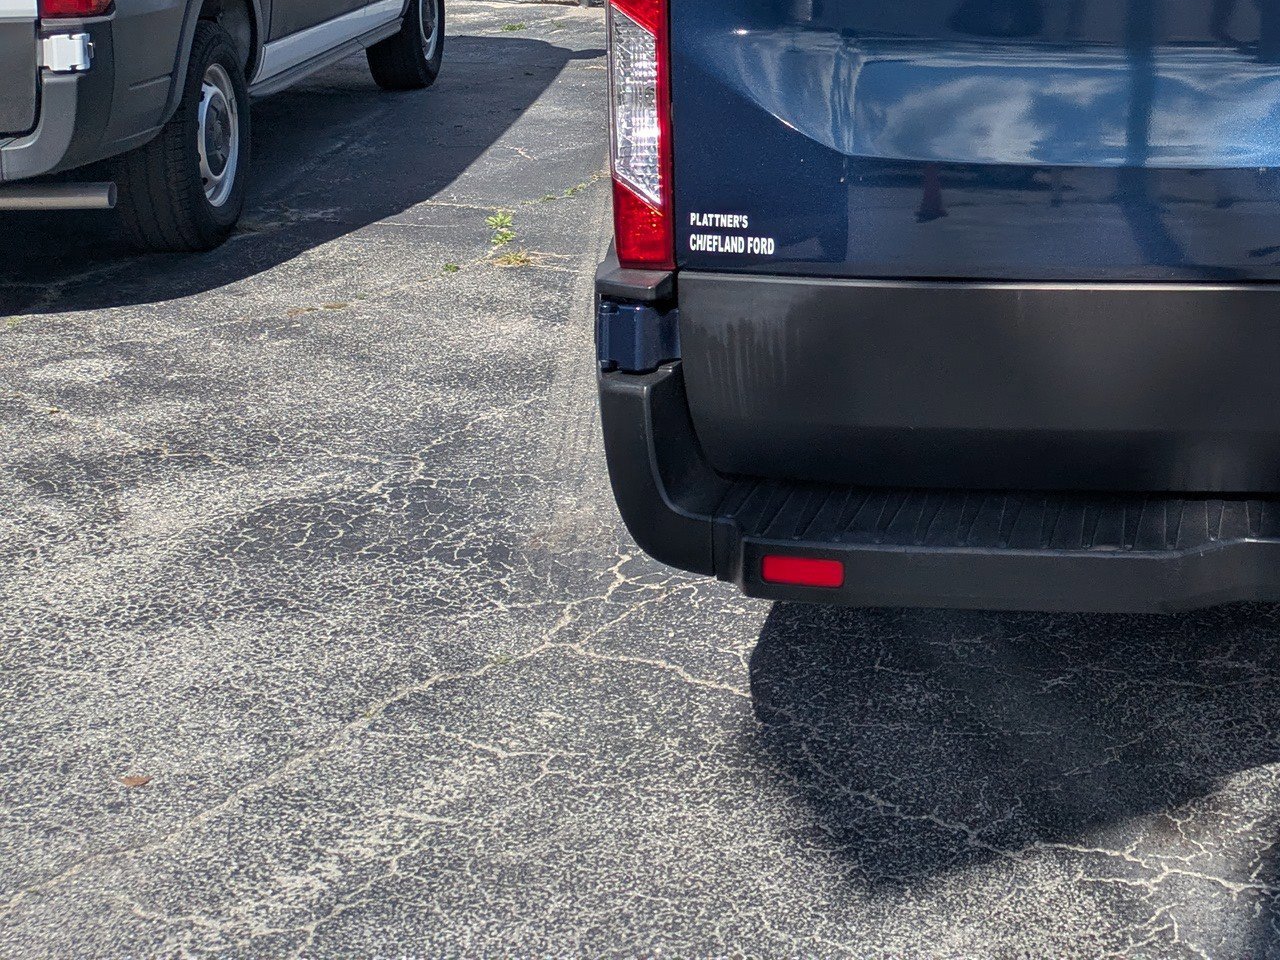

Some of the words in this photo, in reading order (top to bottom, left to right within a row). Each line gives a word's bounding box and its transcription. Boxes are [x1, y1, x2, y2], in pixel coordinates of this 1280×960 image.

[690, 212, 749, 229] PLATTNER'S
[689, 234, 745, 254] CHIEFLAND
[747, 236, 775, 255] FORD
